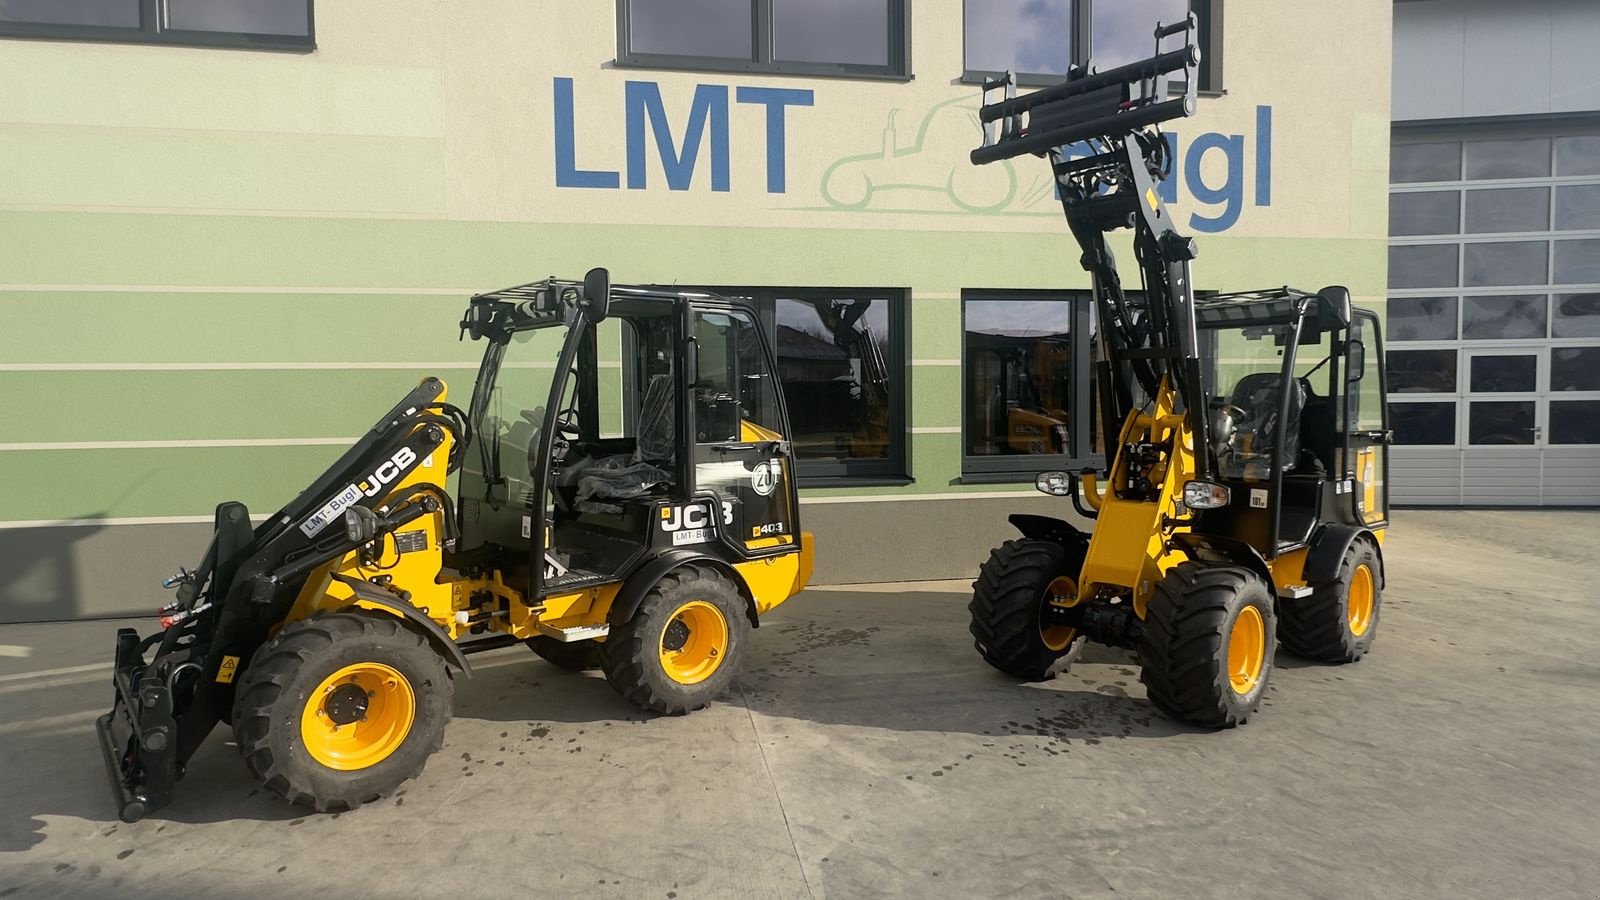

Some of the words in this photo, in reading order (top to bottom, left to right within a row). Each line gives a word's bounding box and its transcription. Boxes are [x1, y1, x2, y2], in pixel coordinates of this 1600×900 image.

[553, 77, 814, 193] LMT
[1055, 105, 1272, 233] gl
[363, 446, 416, 497] JCB
[661, 501, 733, 531] JCB
[761, 522, 783, 533] 403
